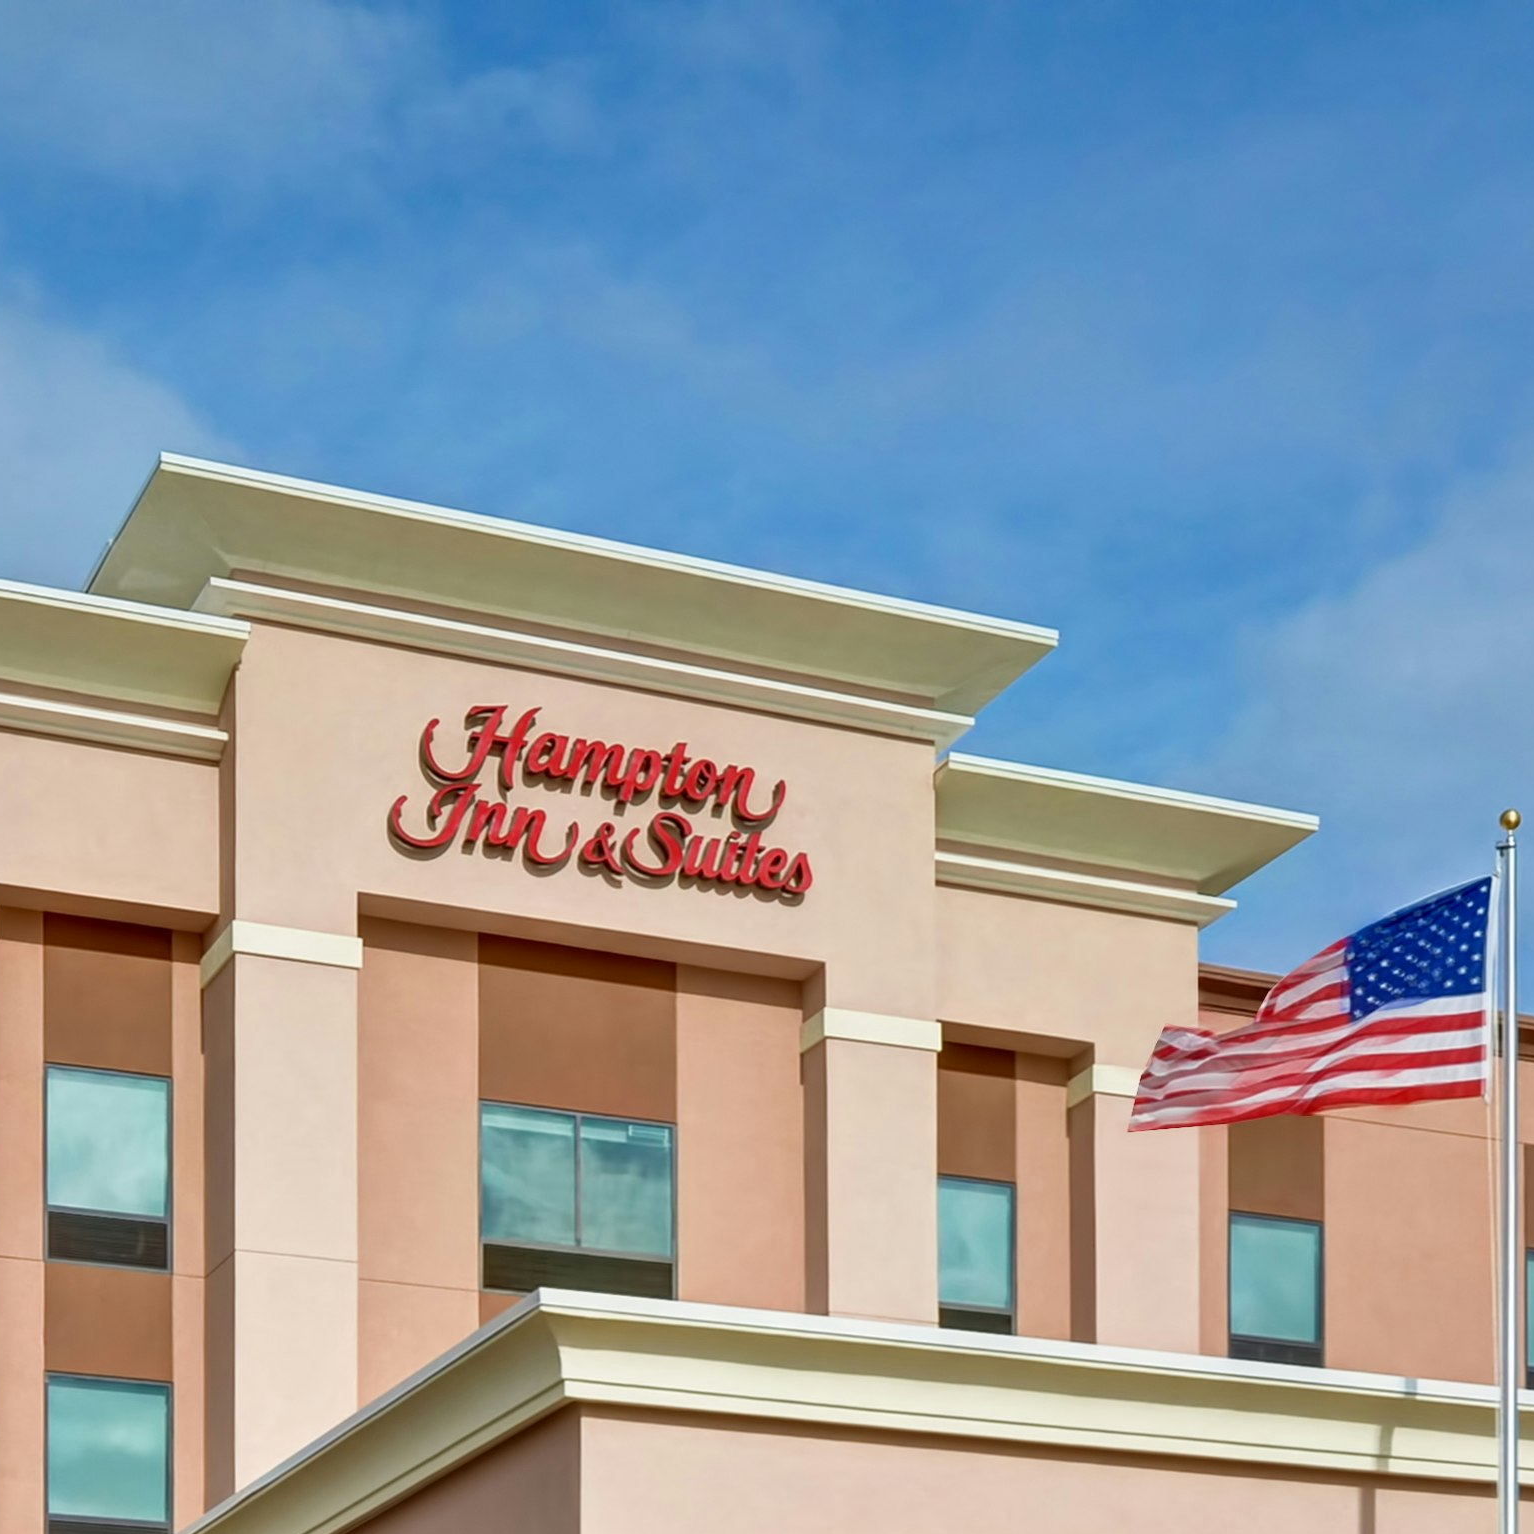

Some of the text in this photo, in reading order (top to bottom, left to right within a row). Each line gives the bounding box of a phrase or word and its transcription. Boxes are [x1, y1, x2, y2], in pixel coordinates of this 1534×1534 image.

[424, 705, 786, 821] Hampton
[392, 783, 814, 894] Inn & Suites
